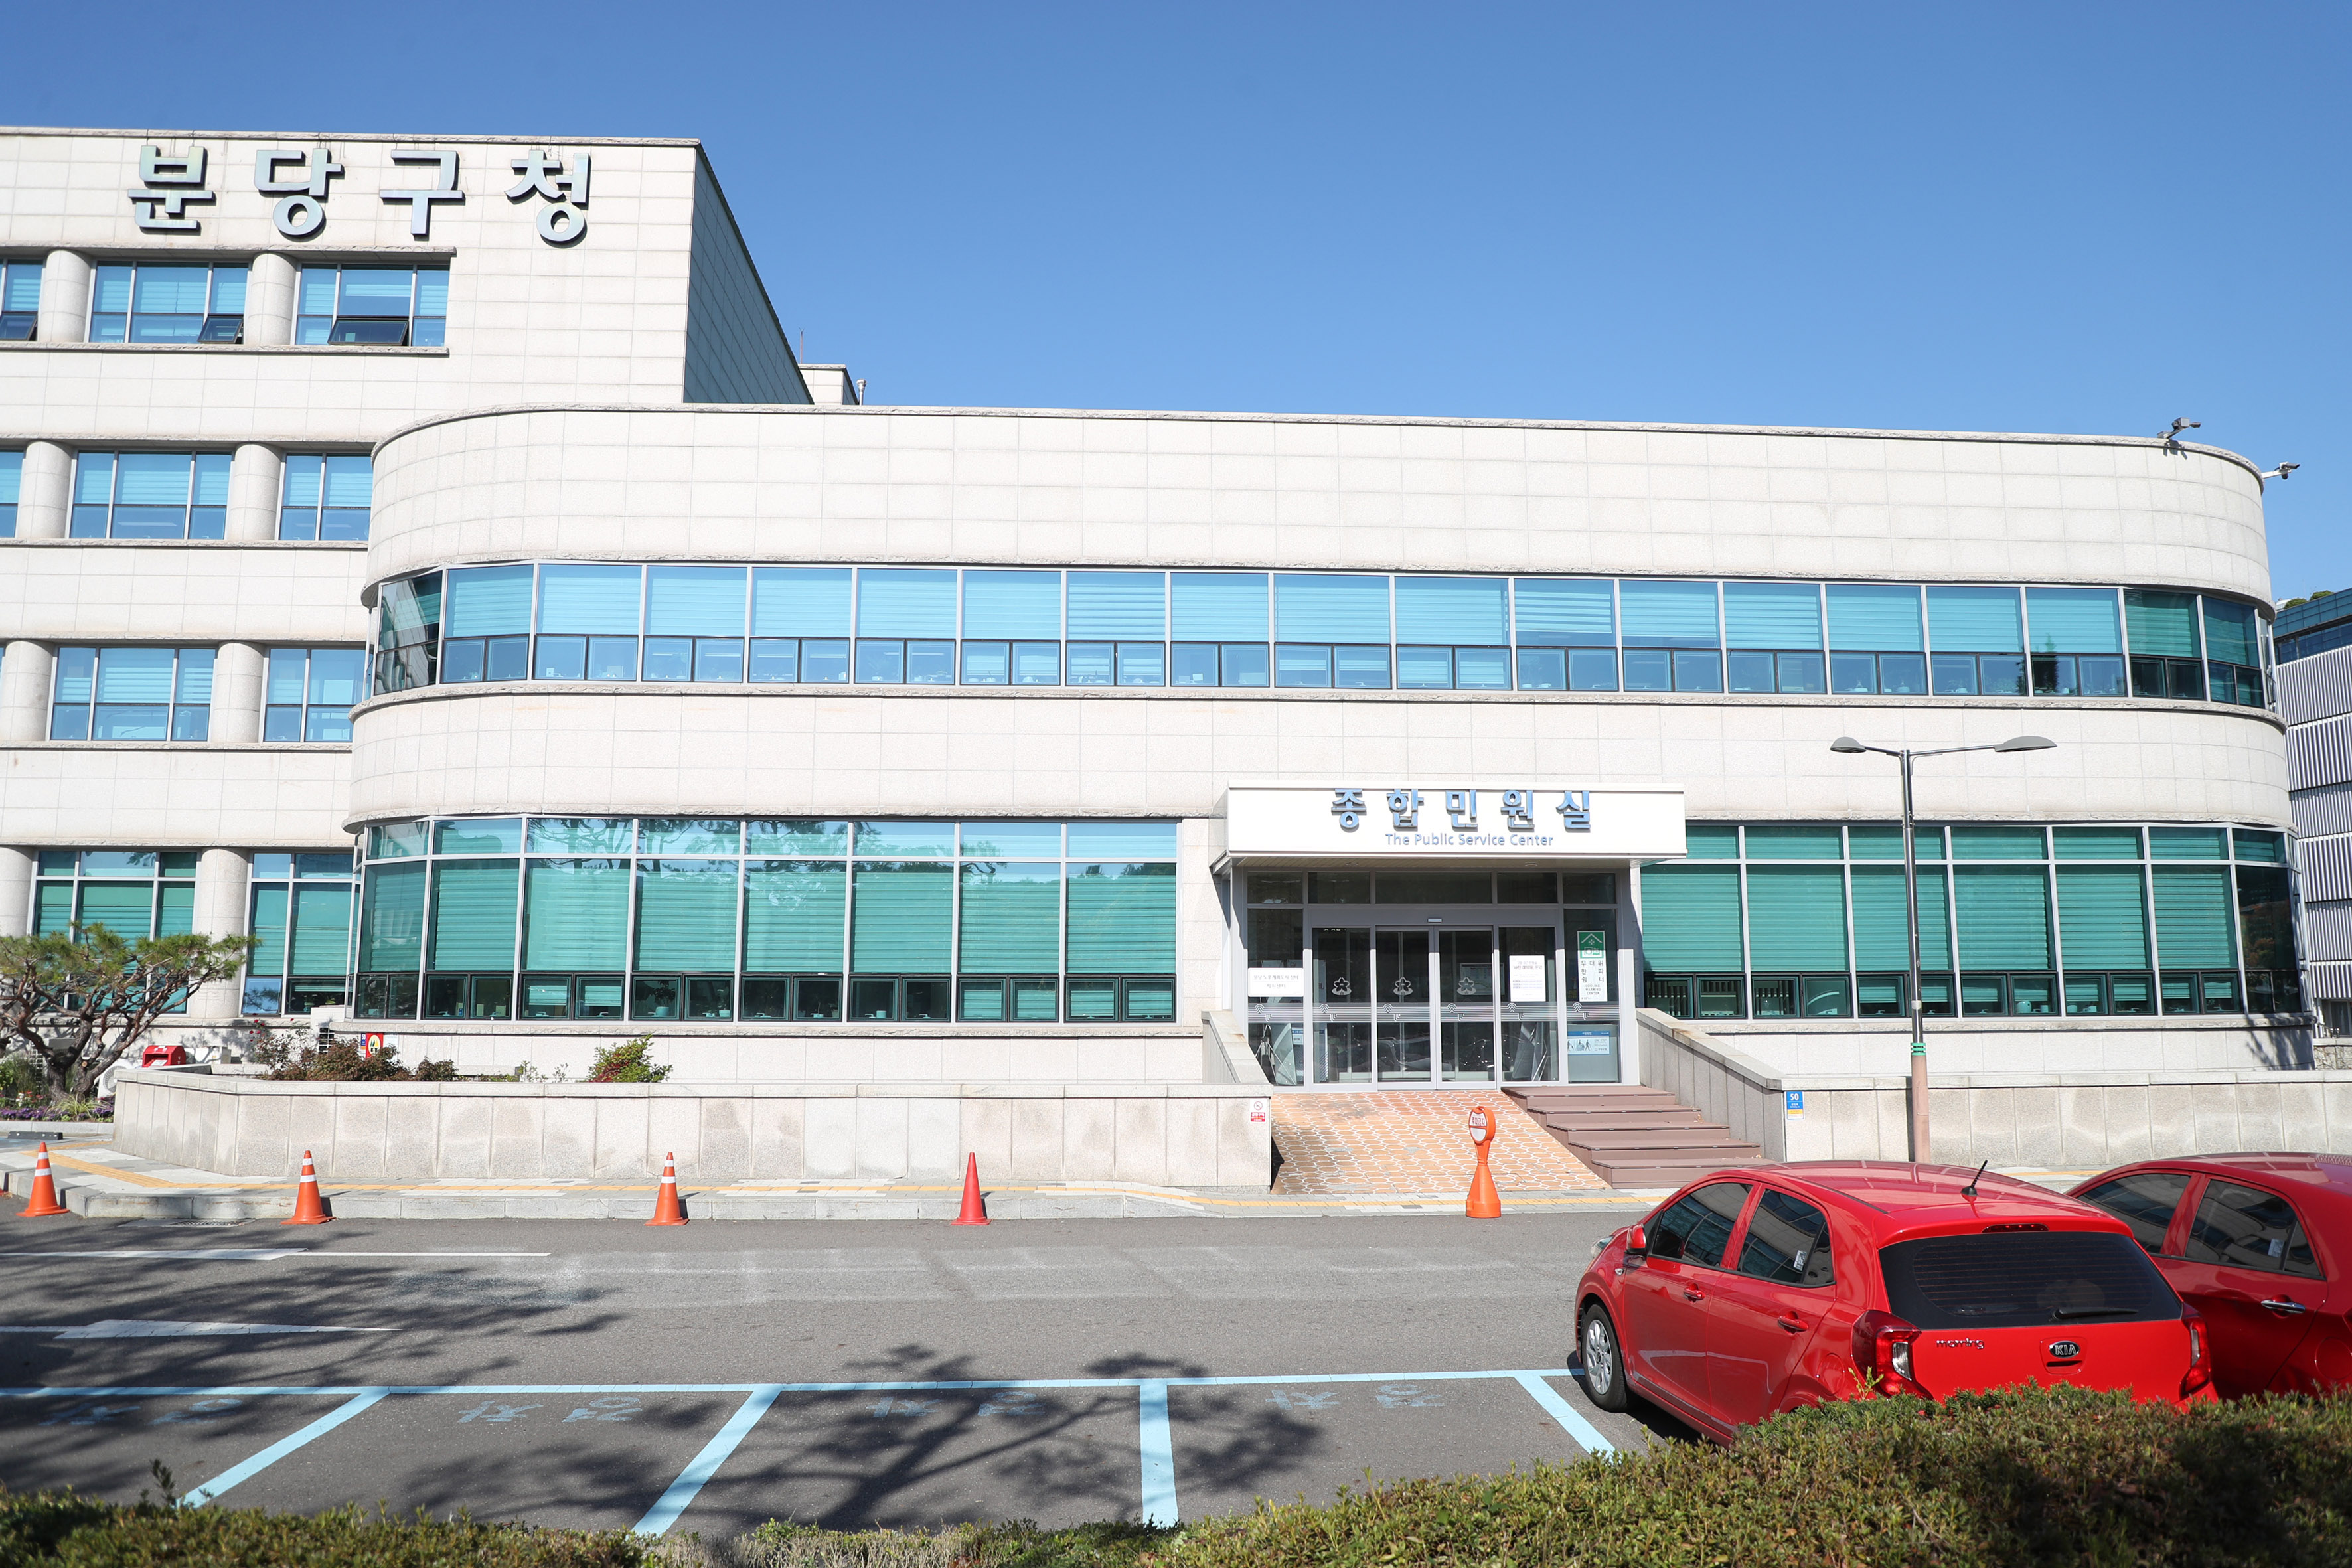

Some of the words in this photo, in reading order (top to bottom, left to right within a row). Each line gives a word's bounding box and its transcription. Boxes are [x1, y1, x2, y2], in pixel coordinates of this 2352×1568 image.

[127, 144, 590, 243] 분당구청
[1330, 788, 1591, 828] 종합민원실
[1385, 833, 1410, 846] The
[1415, 833, 1454, 846] Public
[1458, 833, 1506, 846] Service
[1510, 833, 1554, 846] Center
[1936, 1338, 1985, 1350] morning
[2055, 1344, 2077, 1356] KIA
